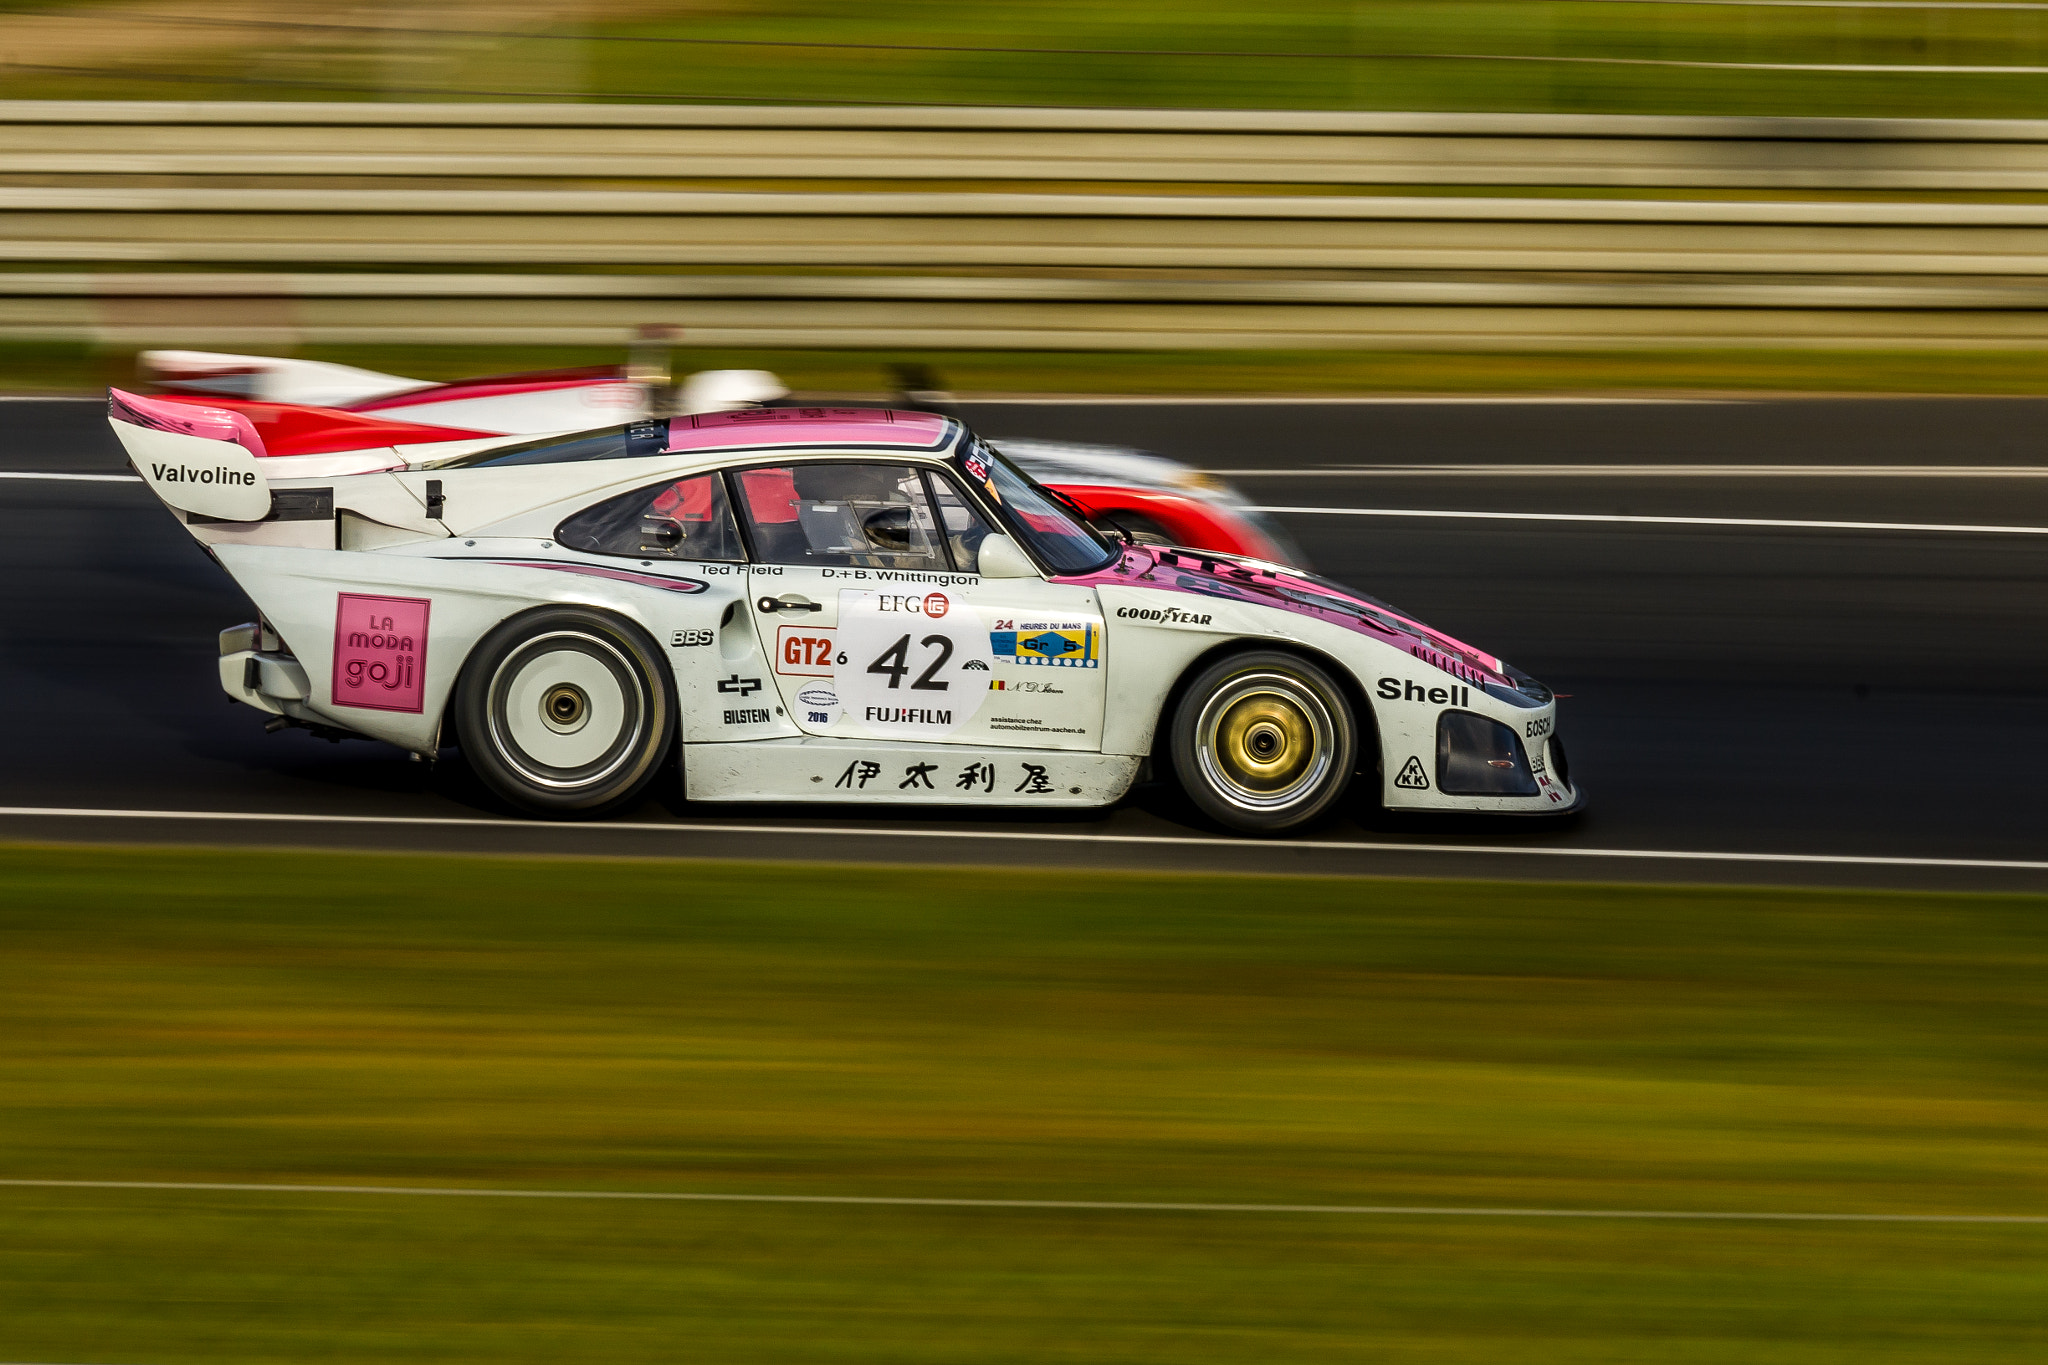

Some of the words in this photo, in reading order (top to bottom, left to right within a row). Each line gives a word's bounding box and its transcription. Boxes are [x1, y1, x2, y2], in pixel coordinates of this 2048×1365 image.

[151, 463, 256, 485] Valvoline
[700, 562, 730, 576] Ted
[735, 562, 784, 577] Field
[821, 568, 873, 580] D.+B.
[876, 570, 979, 588] Whittington
[877, 593, 921, 614] EFG
[369, 614, 394, 631] LA
[994, 619, 1014, 630] 24
[1019, 621, 1048, 631] HEURES
[1049, 621, 1060, 631] DU
[1062, 621, 1082, 631] MANS
[1116, 607, 1212, 626] GOODYEAR
[670, 628, 715, 648] BBS
[1023, 638, 1049, 651] Gr
[1063, 640, 1077, 652] 5
[784, 637, 832, 666] GT2
[836, 651, 848, 665] 6
[344, 653, 414, 690] goji
[866, 633, 954, 691] 42
[1376, 677, 1469, 707] Shell
[723, 708, 771, 725] BILSTEIN
[807, 711, 829, 724] 2016
[866, 707, 952, 725] FUJIFILM
[990, 724, 1086, 734] automobilzentrum-aachen.de
[1526, 716, 1551, 738] BOSCH
[834, 760, 1055, 793] 伊太利屋
[1409, 764, 1419, 775] K
